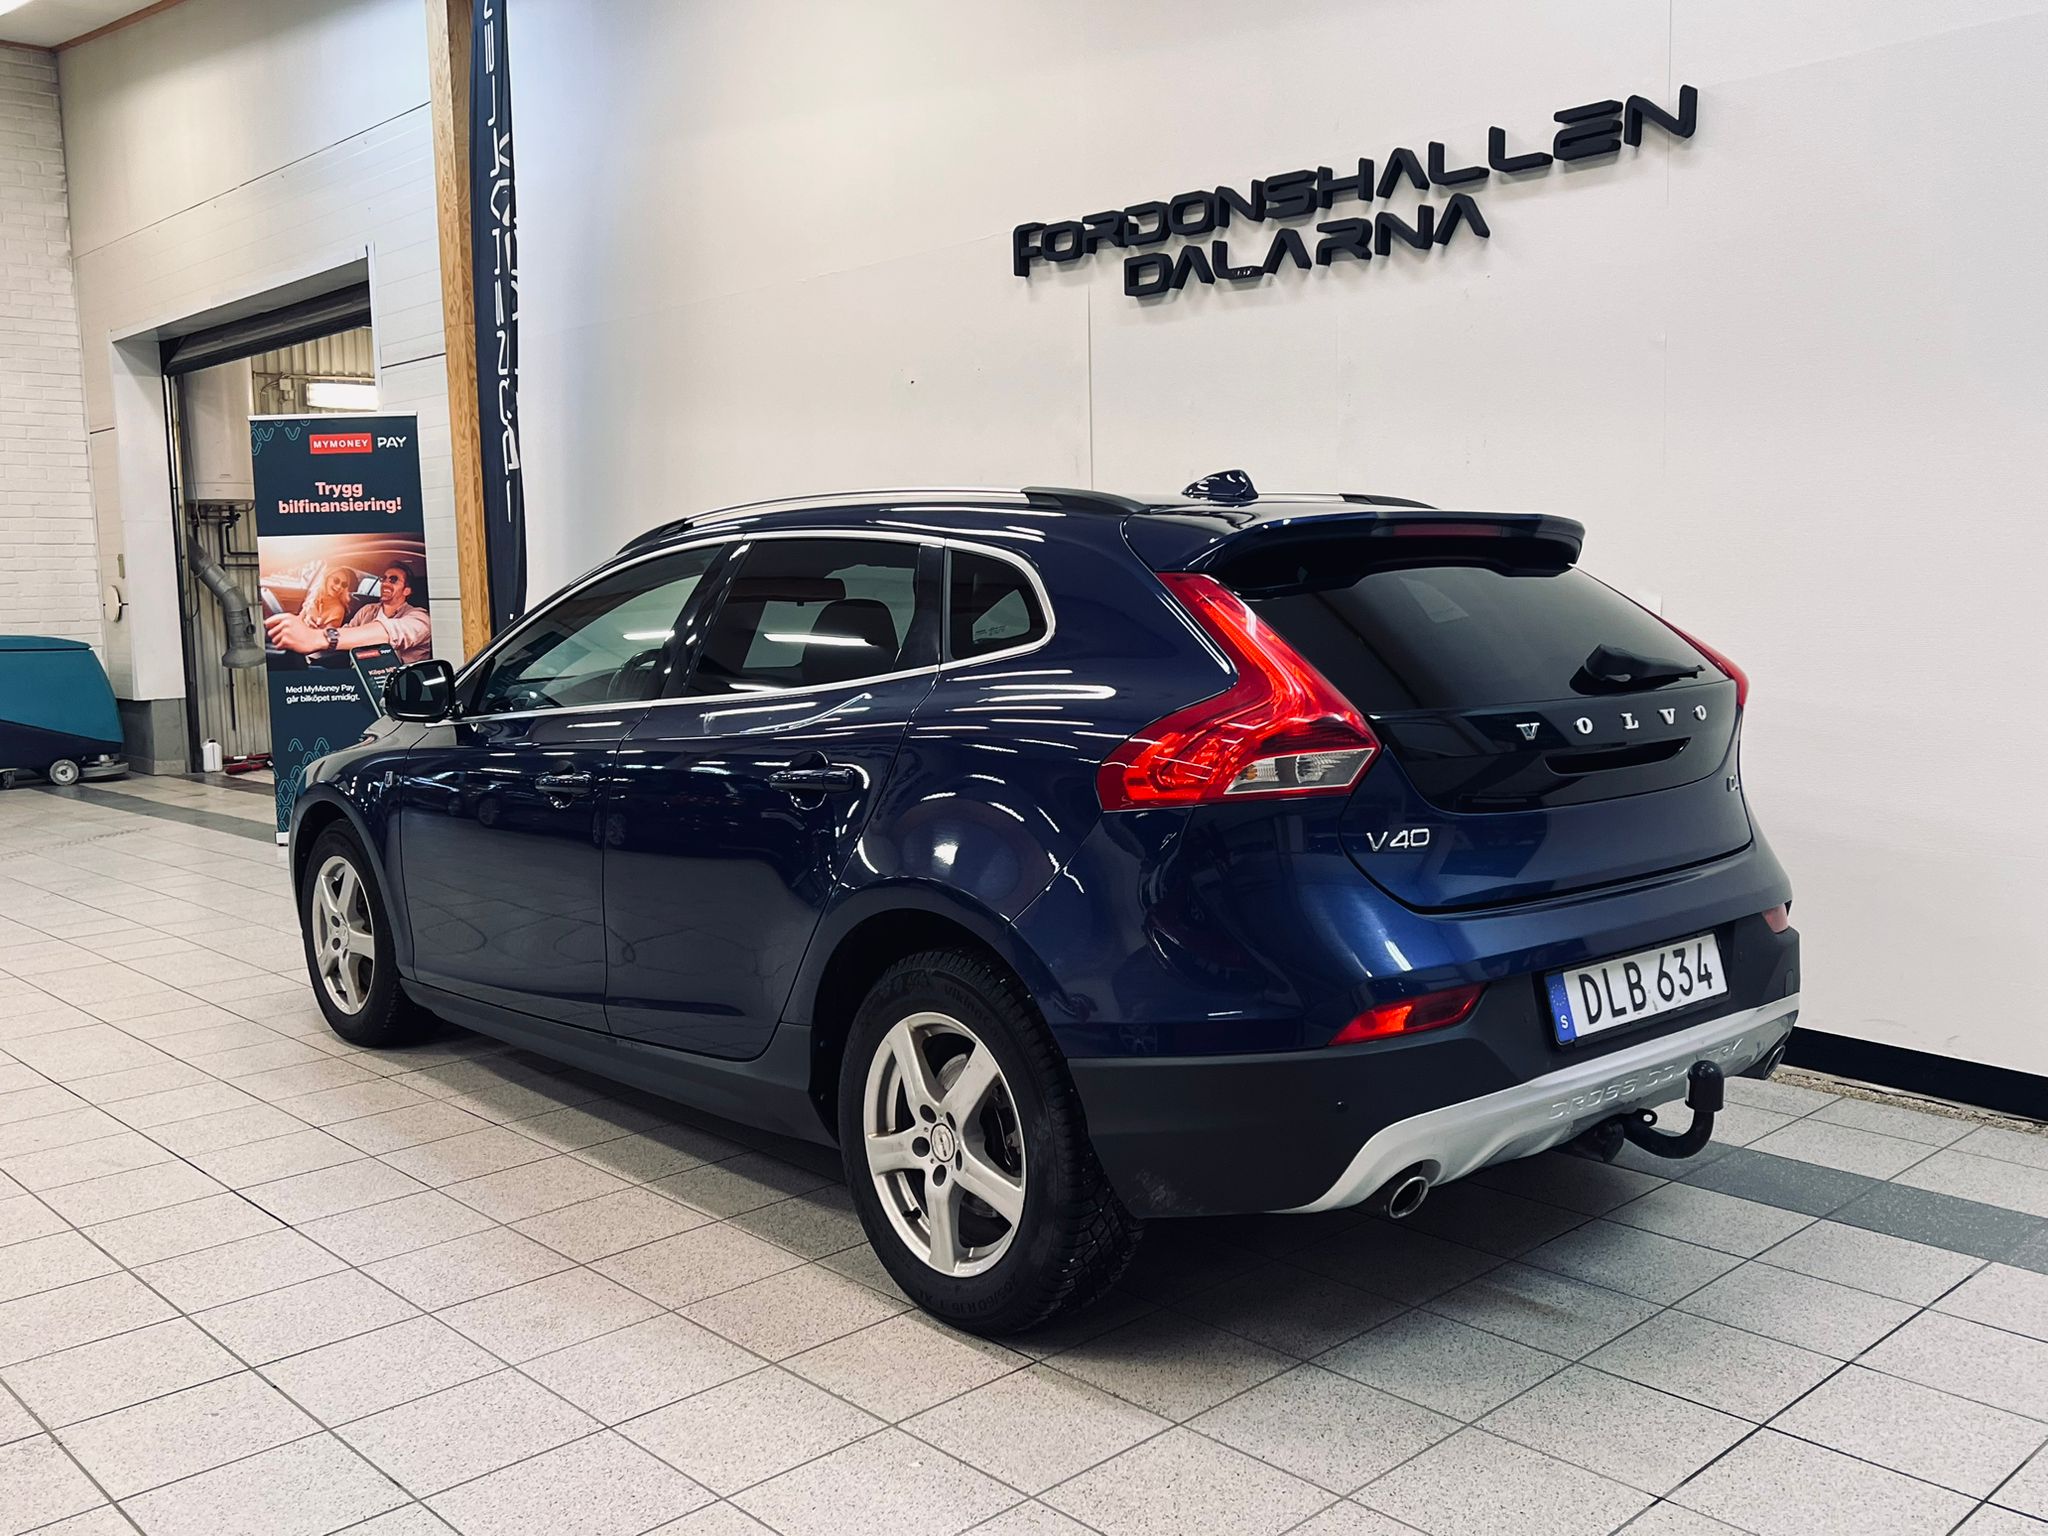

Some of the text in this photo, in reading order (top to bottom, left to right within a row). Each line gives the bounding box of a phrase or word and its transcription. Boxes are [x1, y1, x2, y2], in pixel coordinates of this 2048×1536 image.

[1012, 84, 1699, 278] FORDONSHALLEN
[1123, 192, 1491, 298] DALARNA
[313, 436, 407, 449] MYMONEY PAY
[315, 481, 363, 498] Trygg
[278, 497, 402, 514] bilfinansiering!
[285, 684, 355, 694] Med MyMoney Pay
[286, 693, 360, 704] går bilköpet smidigt.
[1516, 705, 1707, 741] VOLVO
[1366, 828, 1430, 852] V40
[1578, 943, 1713, 1025] DLB 634
[1559, 1015, 1569, 1030] S
[1548, 1078, 1639, 1120] CROSS
